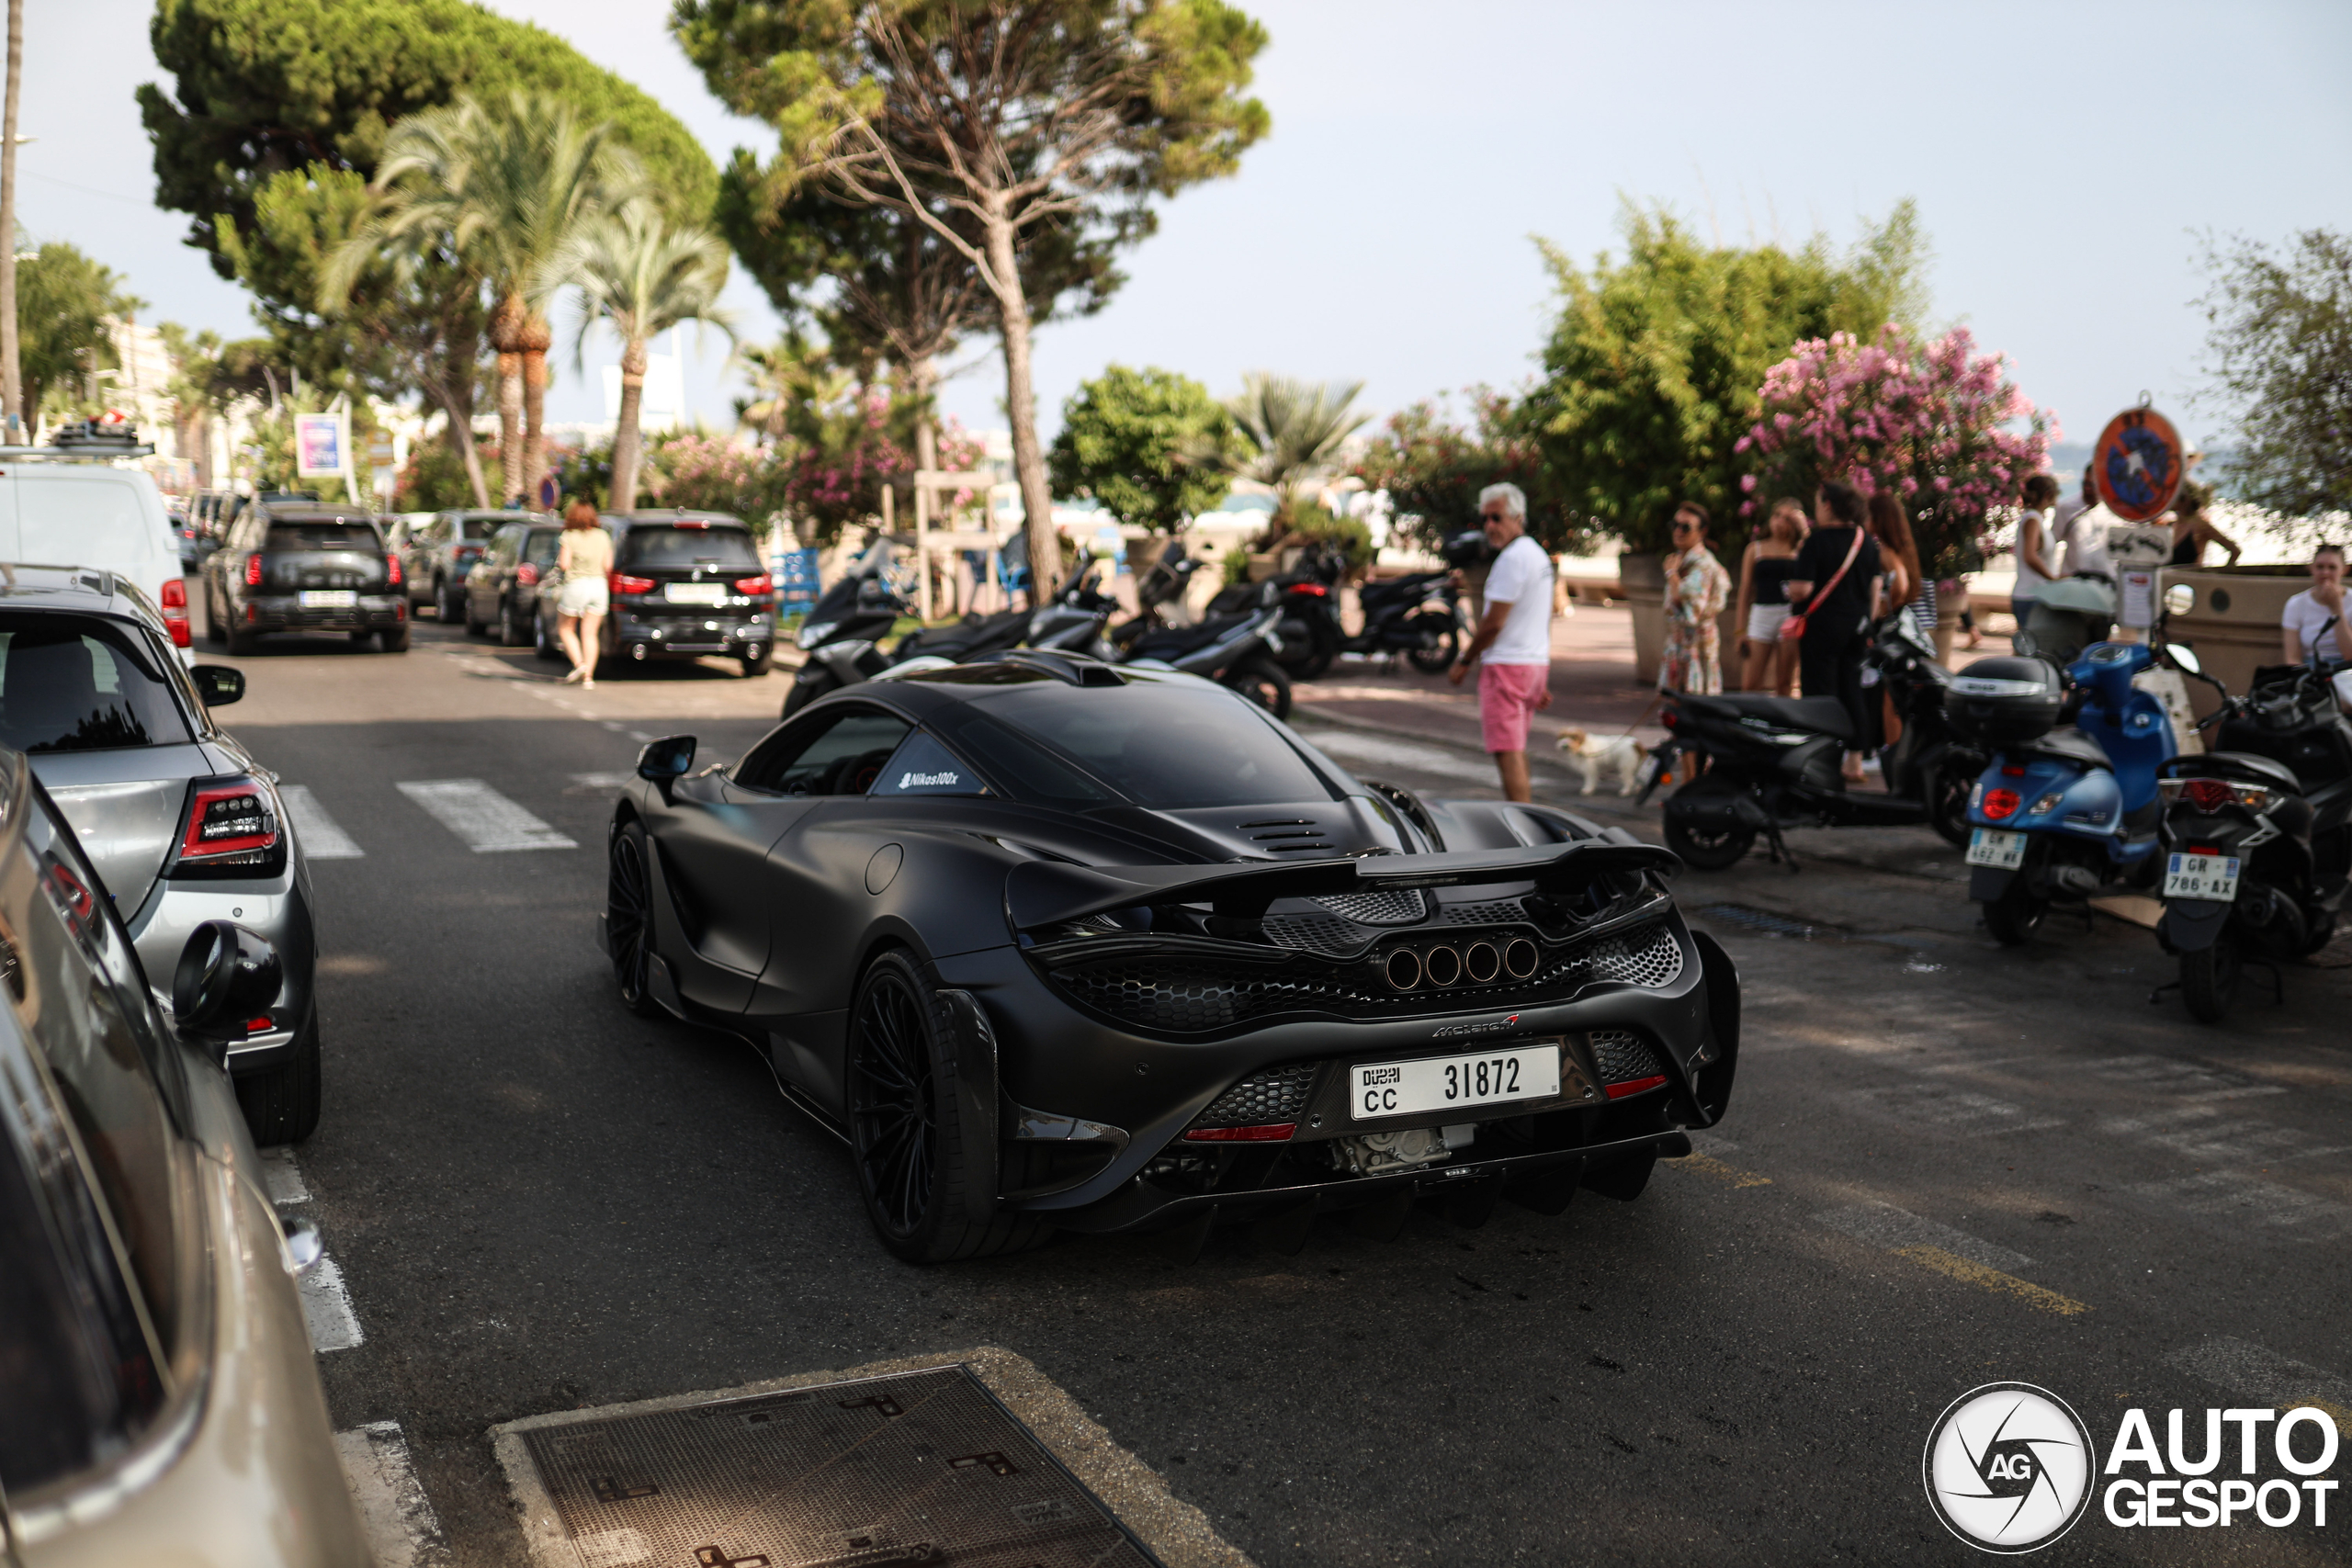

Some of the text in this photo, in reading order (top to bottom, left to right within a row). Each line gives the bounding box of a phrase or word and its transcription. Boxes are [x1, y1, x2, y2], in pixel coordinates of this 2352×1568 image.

[910, 772, 958, 786] Nikos100x
[1432, 1021, 1511, 1038] McLaren
[1444, 1057, 1521, 1100] 31872
[1364, 1089, 1397, 1112] CC
